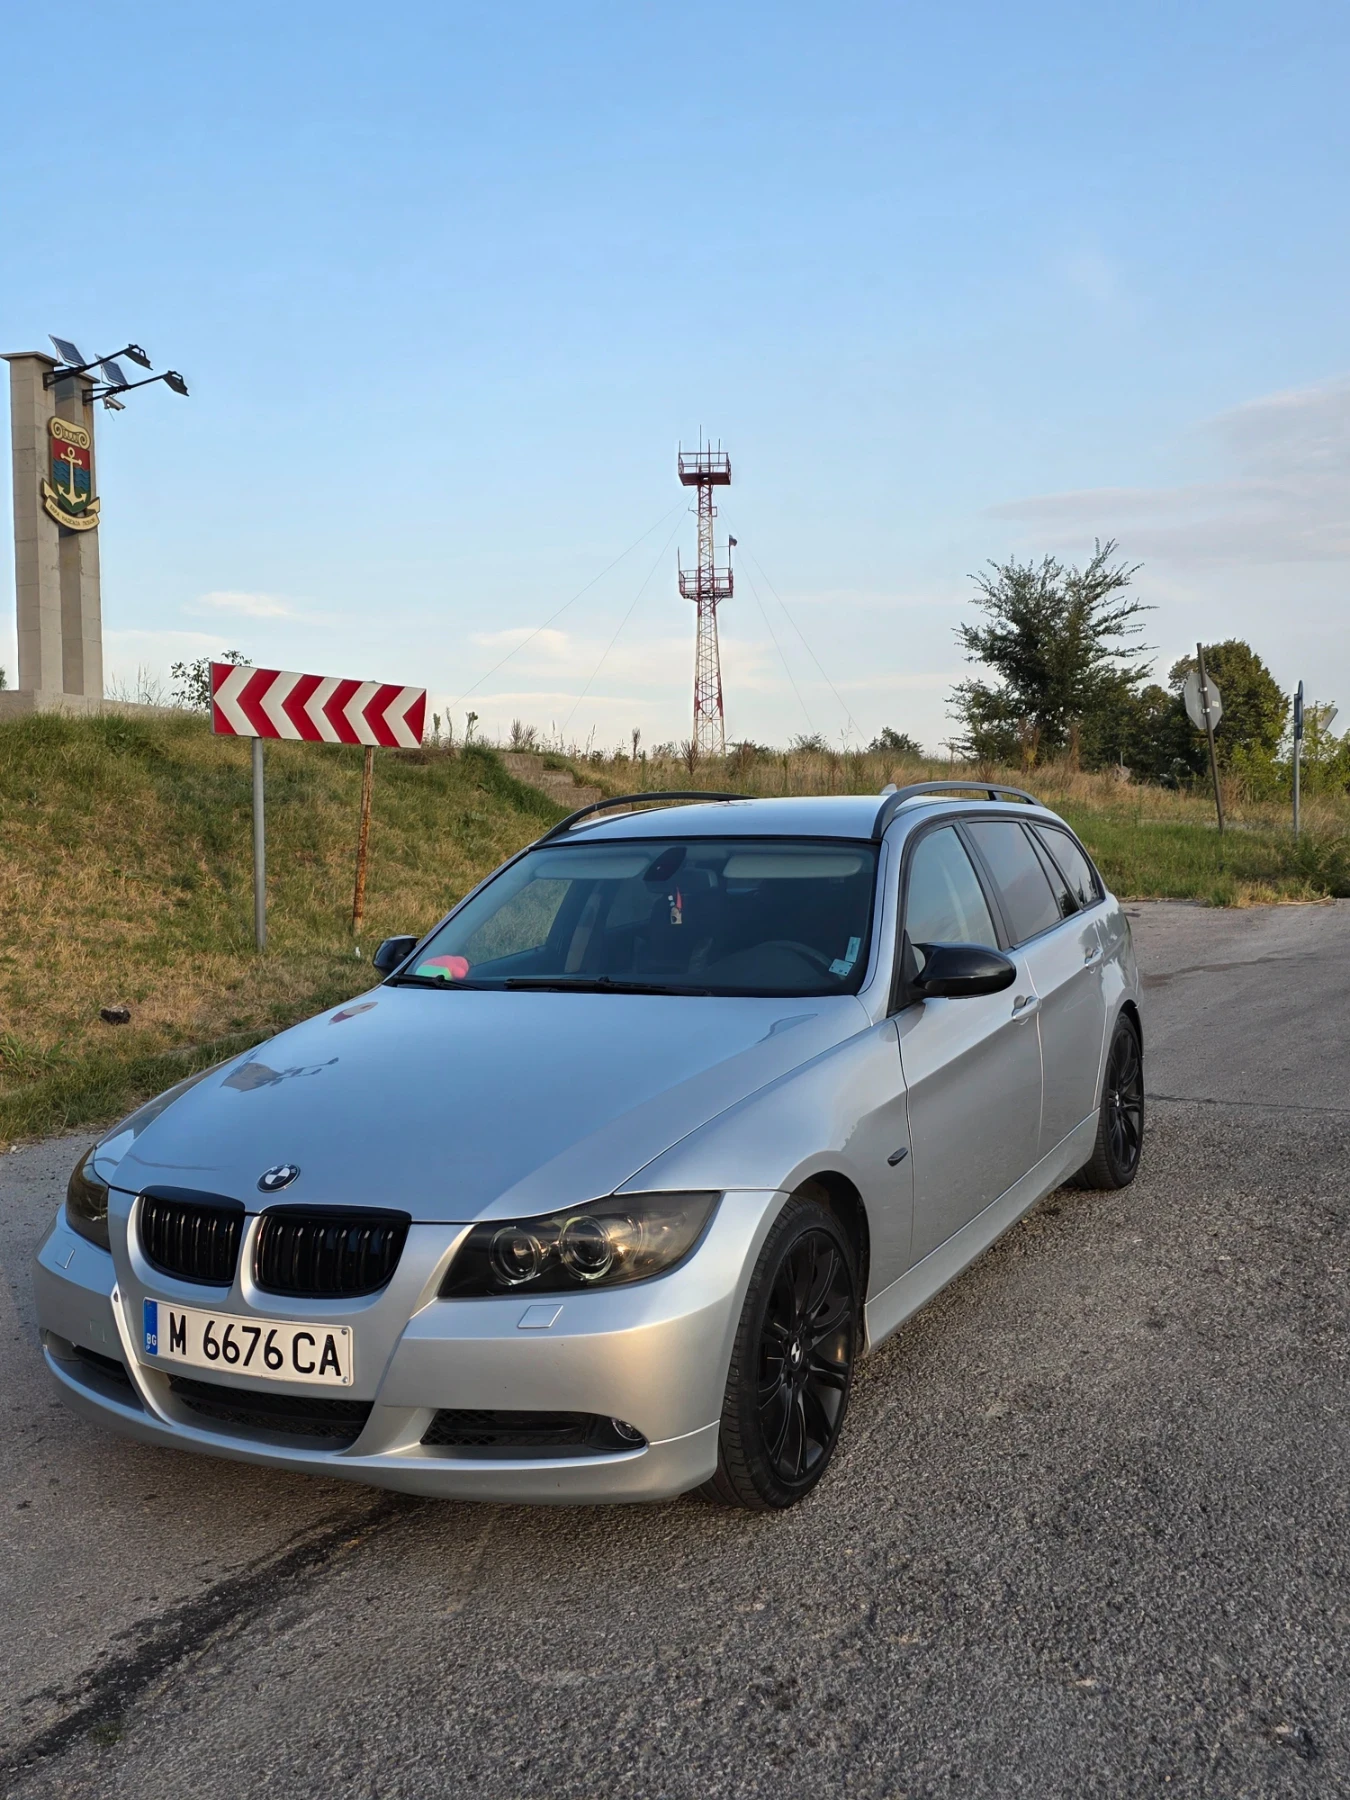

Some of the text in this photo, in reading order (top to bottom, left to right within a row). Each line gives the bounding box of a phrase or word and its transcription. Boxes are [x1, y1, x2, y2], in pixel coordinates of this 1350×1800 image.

[146, 1332, 157, 1347] BG
[169, 1312, 342, 1376] M 6676 CA
